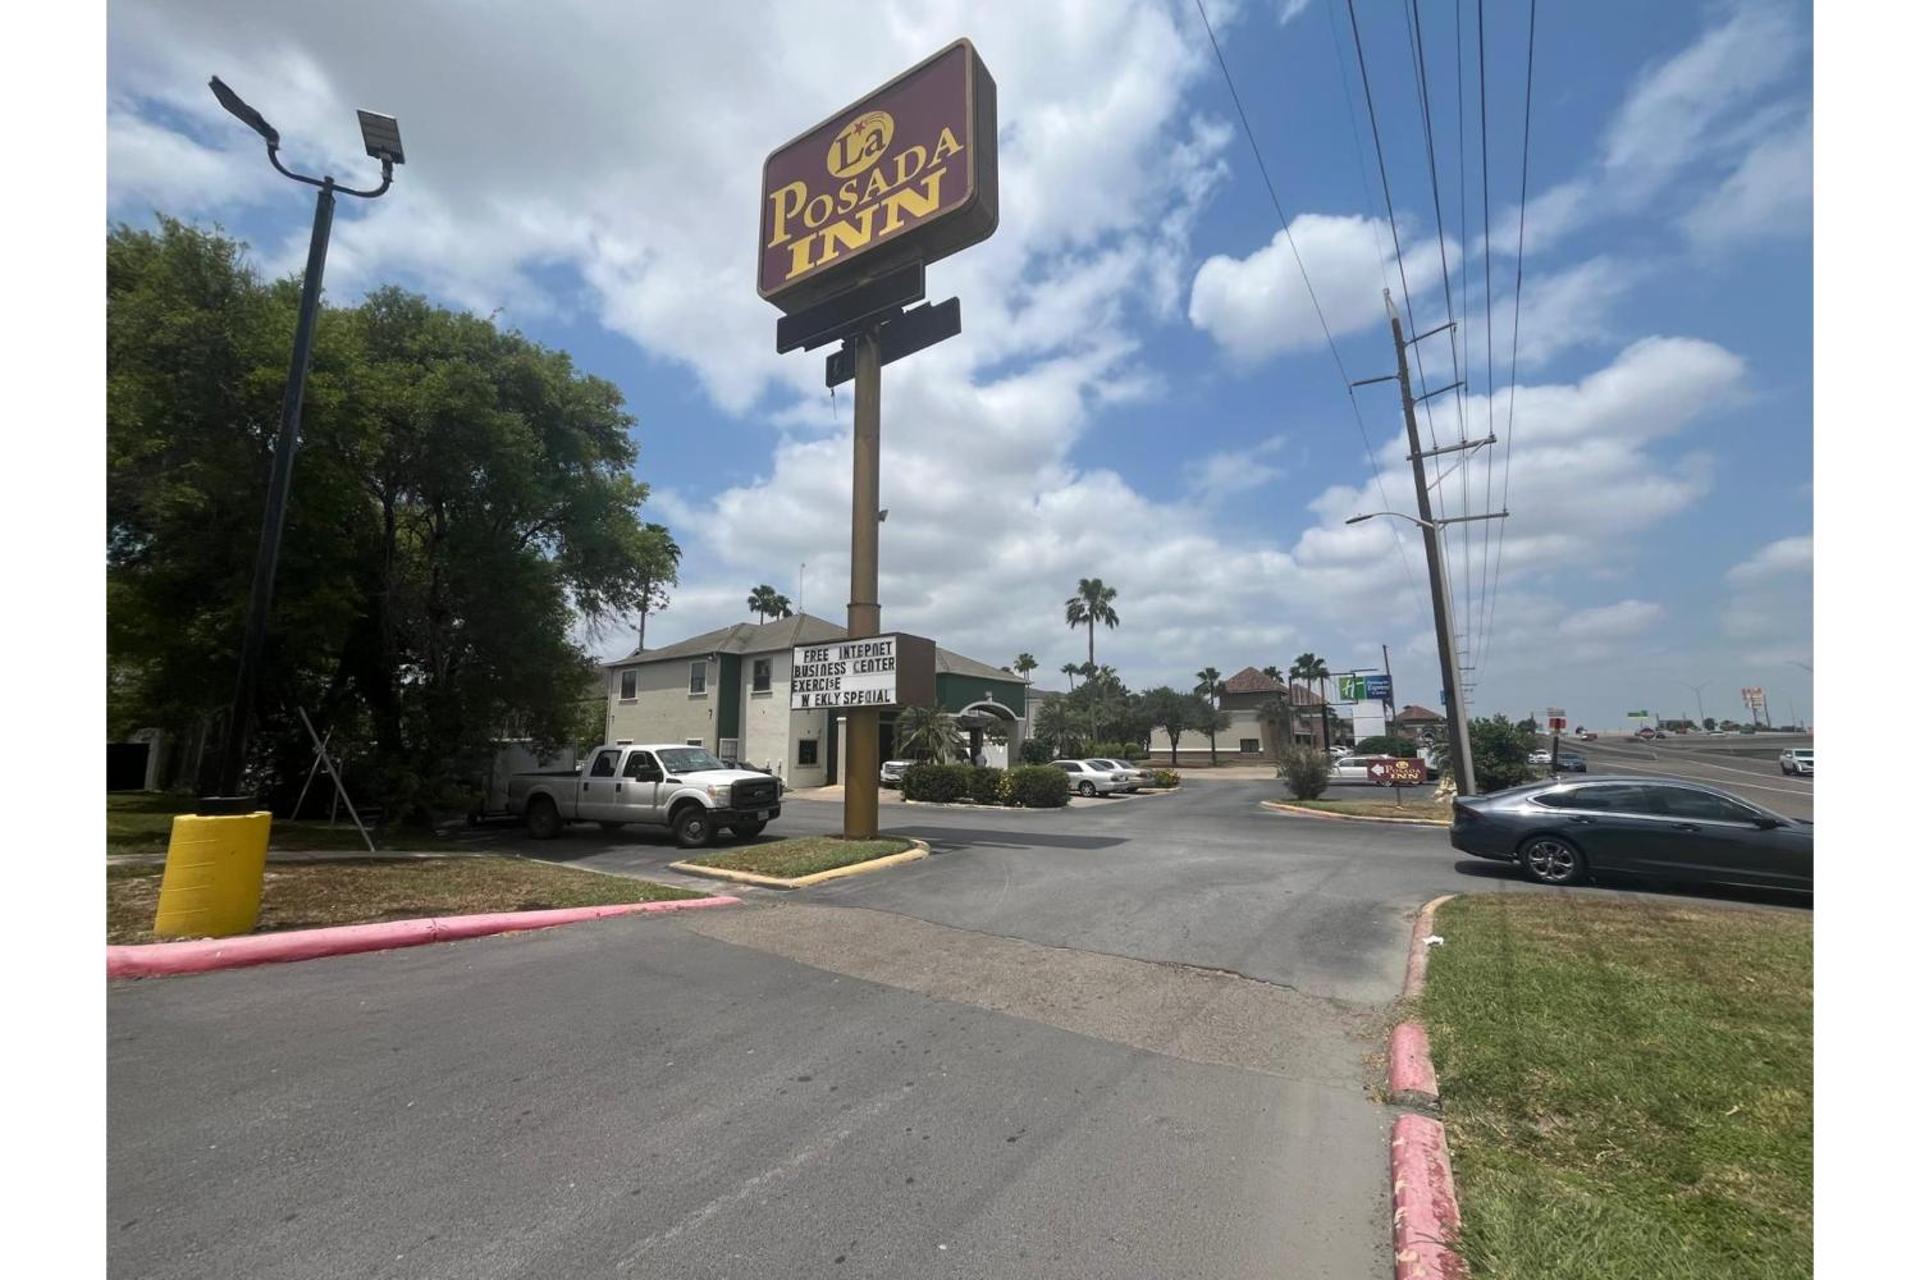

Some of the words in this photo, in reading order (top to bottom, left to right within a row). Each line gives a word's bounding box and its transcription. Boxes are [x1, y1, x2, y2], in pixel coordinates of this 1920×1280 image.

[835, 127, 885, 174] La
[767, 127, 964, 248] POSADA
[785, 167, 947, 280] INN
[794, 661, 846, 678] BUSINESS
[853, 657, 896, 674] CENTER
[804, 648, 829, 663] FREE
[792, 677, 841, 692] EXERCISE
